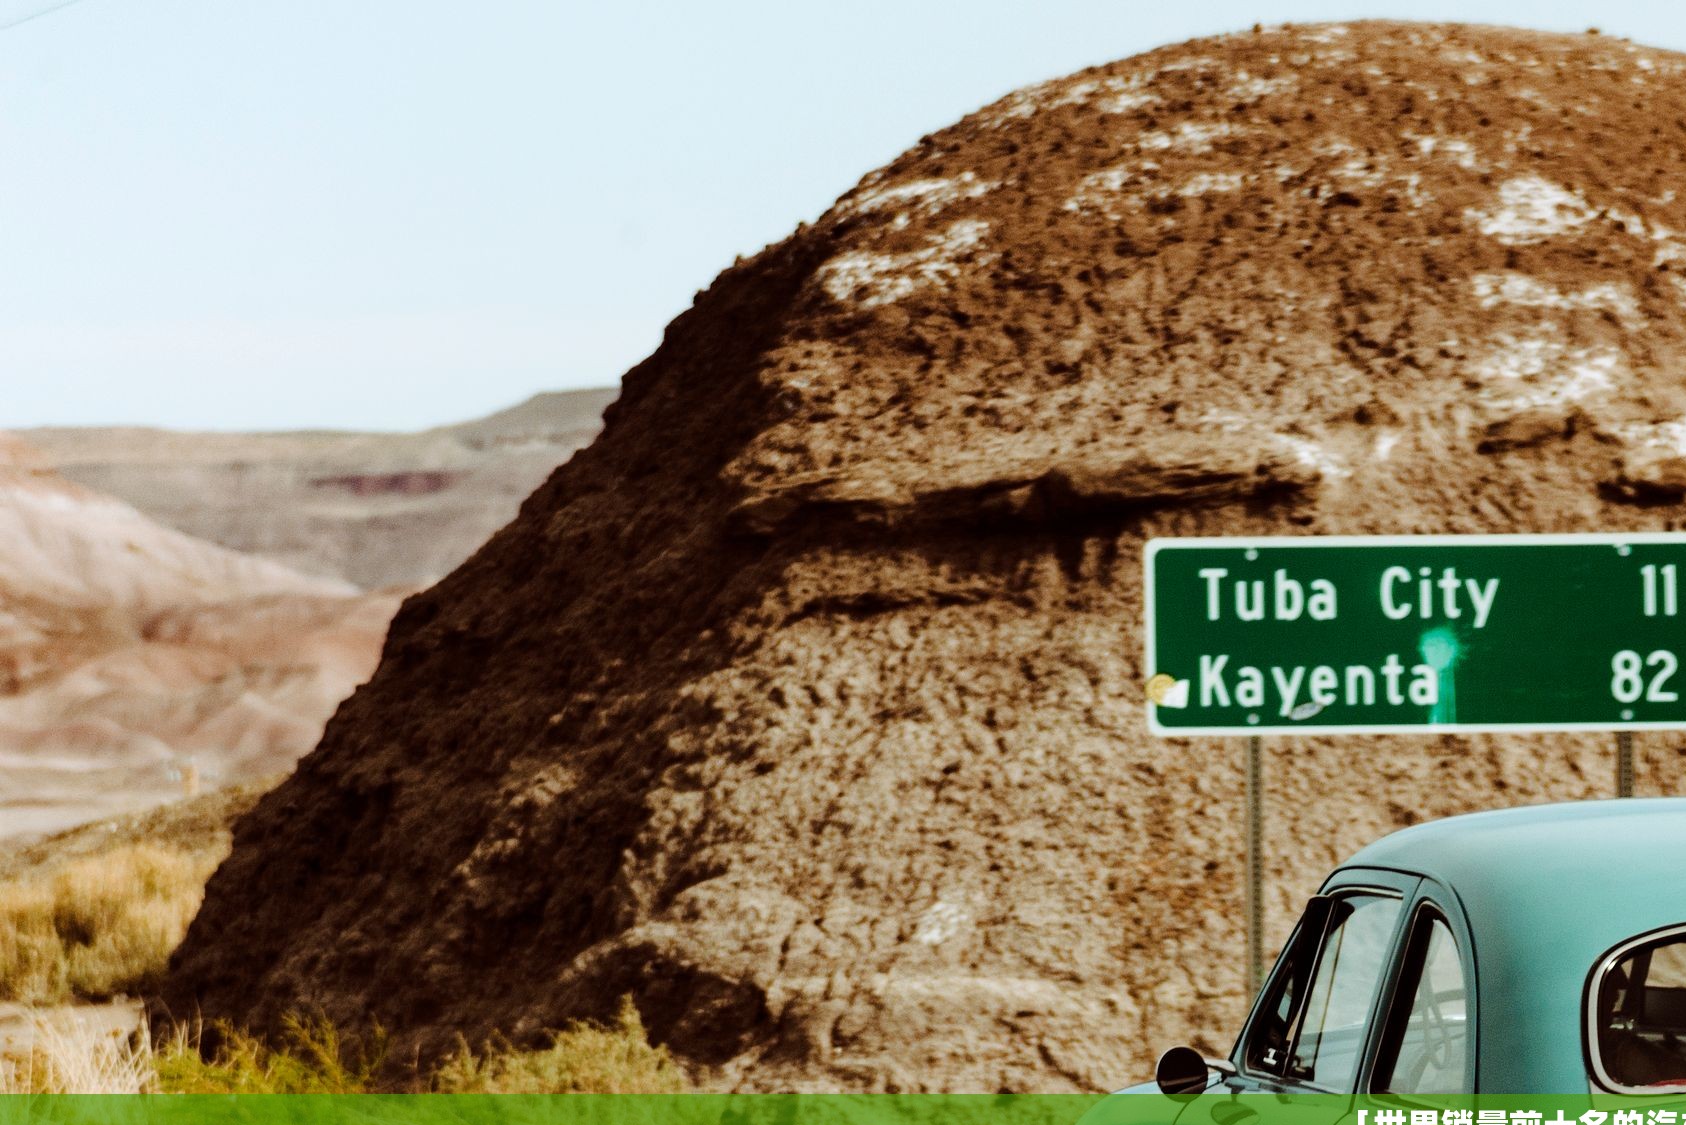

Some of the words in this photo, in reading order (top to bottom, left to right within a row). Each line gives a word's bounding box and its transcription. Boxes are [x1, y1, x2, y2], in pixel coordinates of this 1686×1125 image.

[1199, 568, 1337, 621] Tuba
[1380, 566, 1499, 628] City
[1641, 564, 1677, 616] 11
[1200, 654, 1439, 717] Kayenta
[1611, 649, 1678, 703] 82
